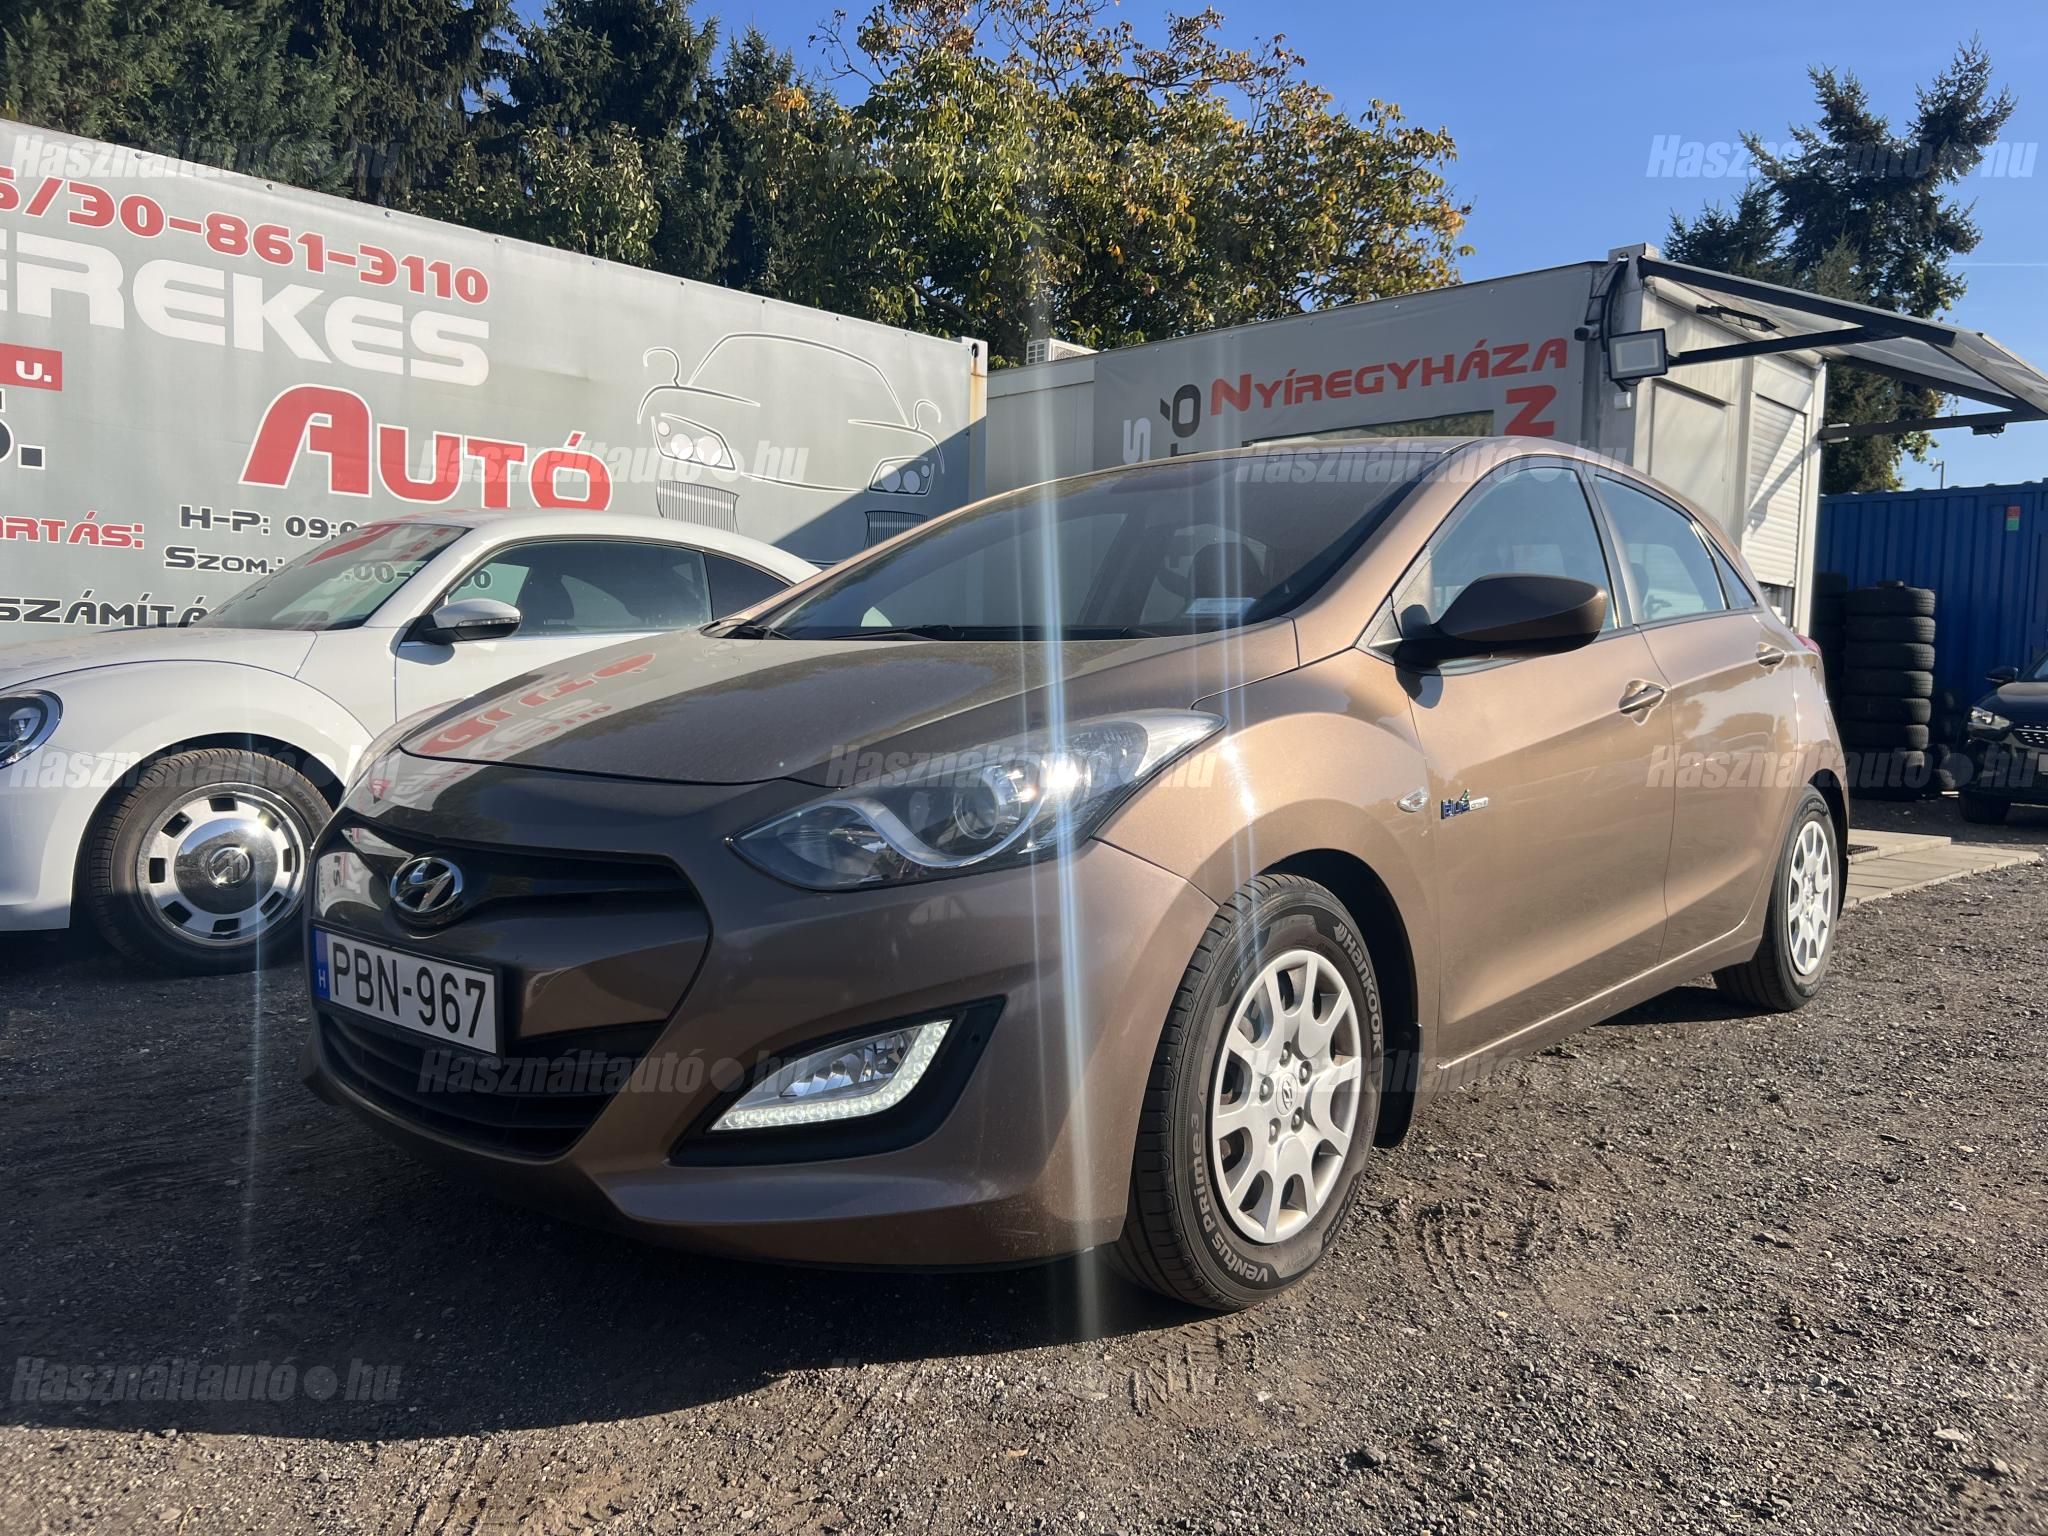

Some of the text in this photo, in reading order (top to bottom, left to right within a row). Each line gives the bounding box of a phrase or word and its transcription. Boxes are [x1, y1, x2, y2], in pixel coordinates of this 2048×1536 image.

[0, 228, 490, 386] REKES
[15, 360, 52, 383] u.
[1211, 337, 1568, 416] NYÍREGYHÁZA
[0, 511, 145, 549] RTÁS:
[179, 504, 271, 536] H-P:
[332, 941, 487, 1039] PBN-967
[1343, 933, 1382, 1054] Hankook
